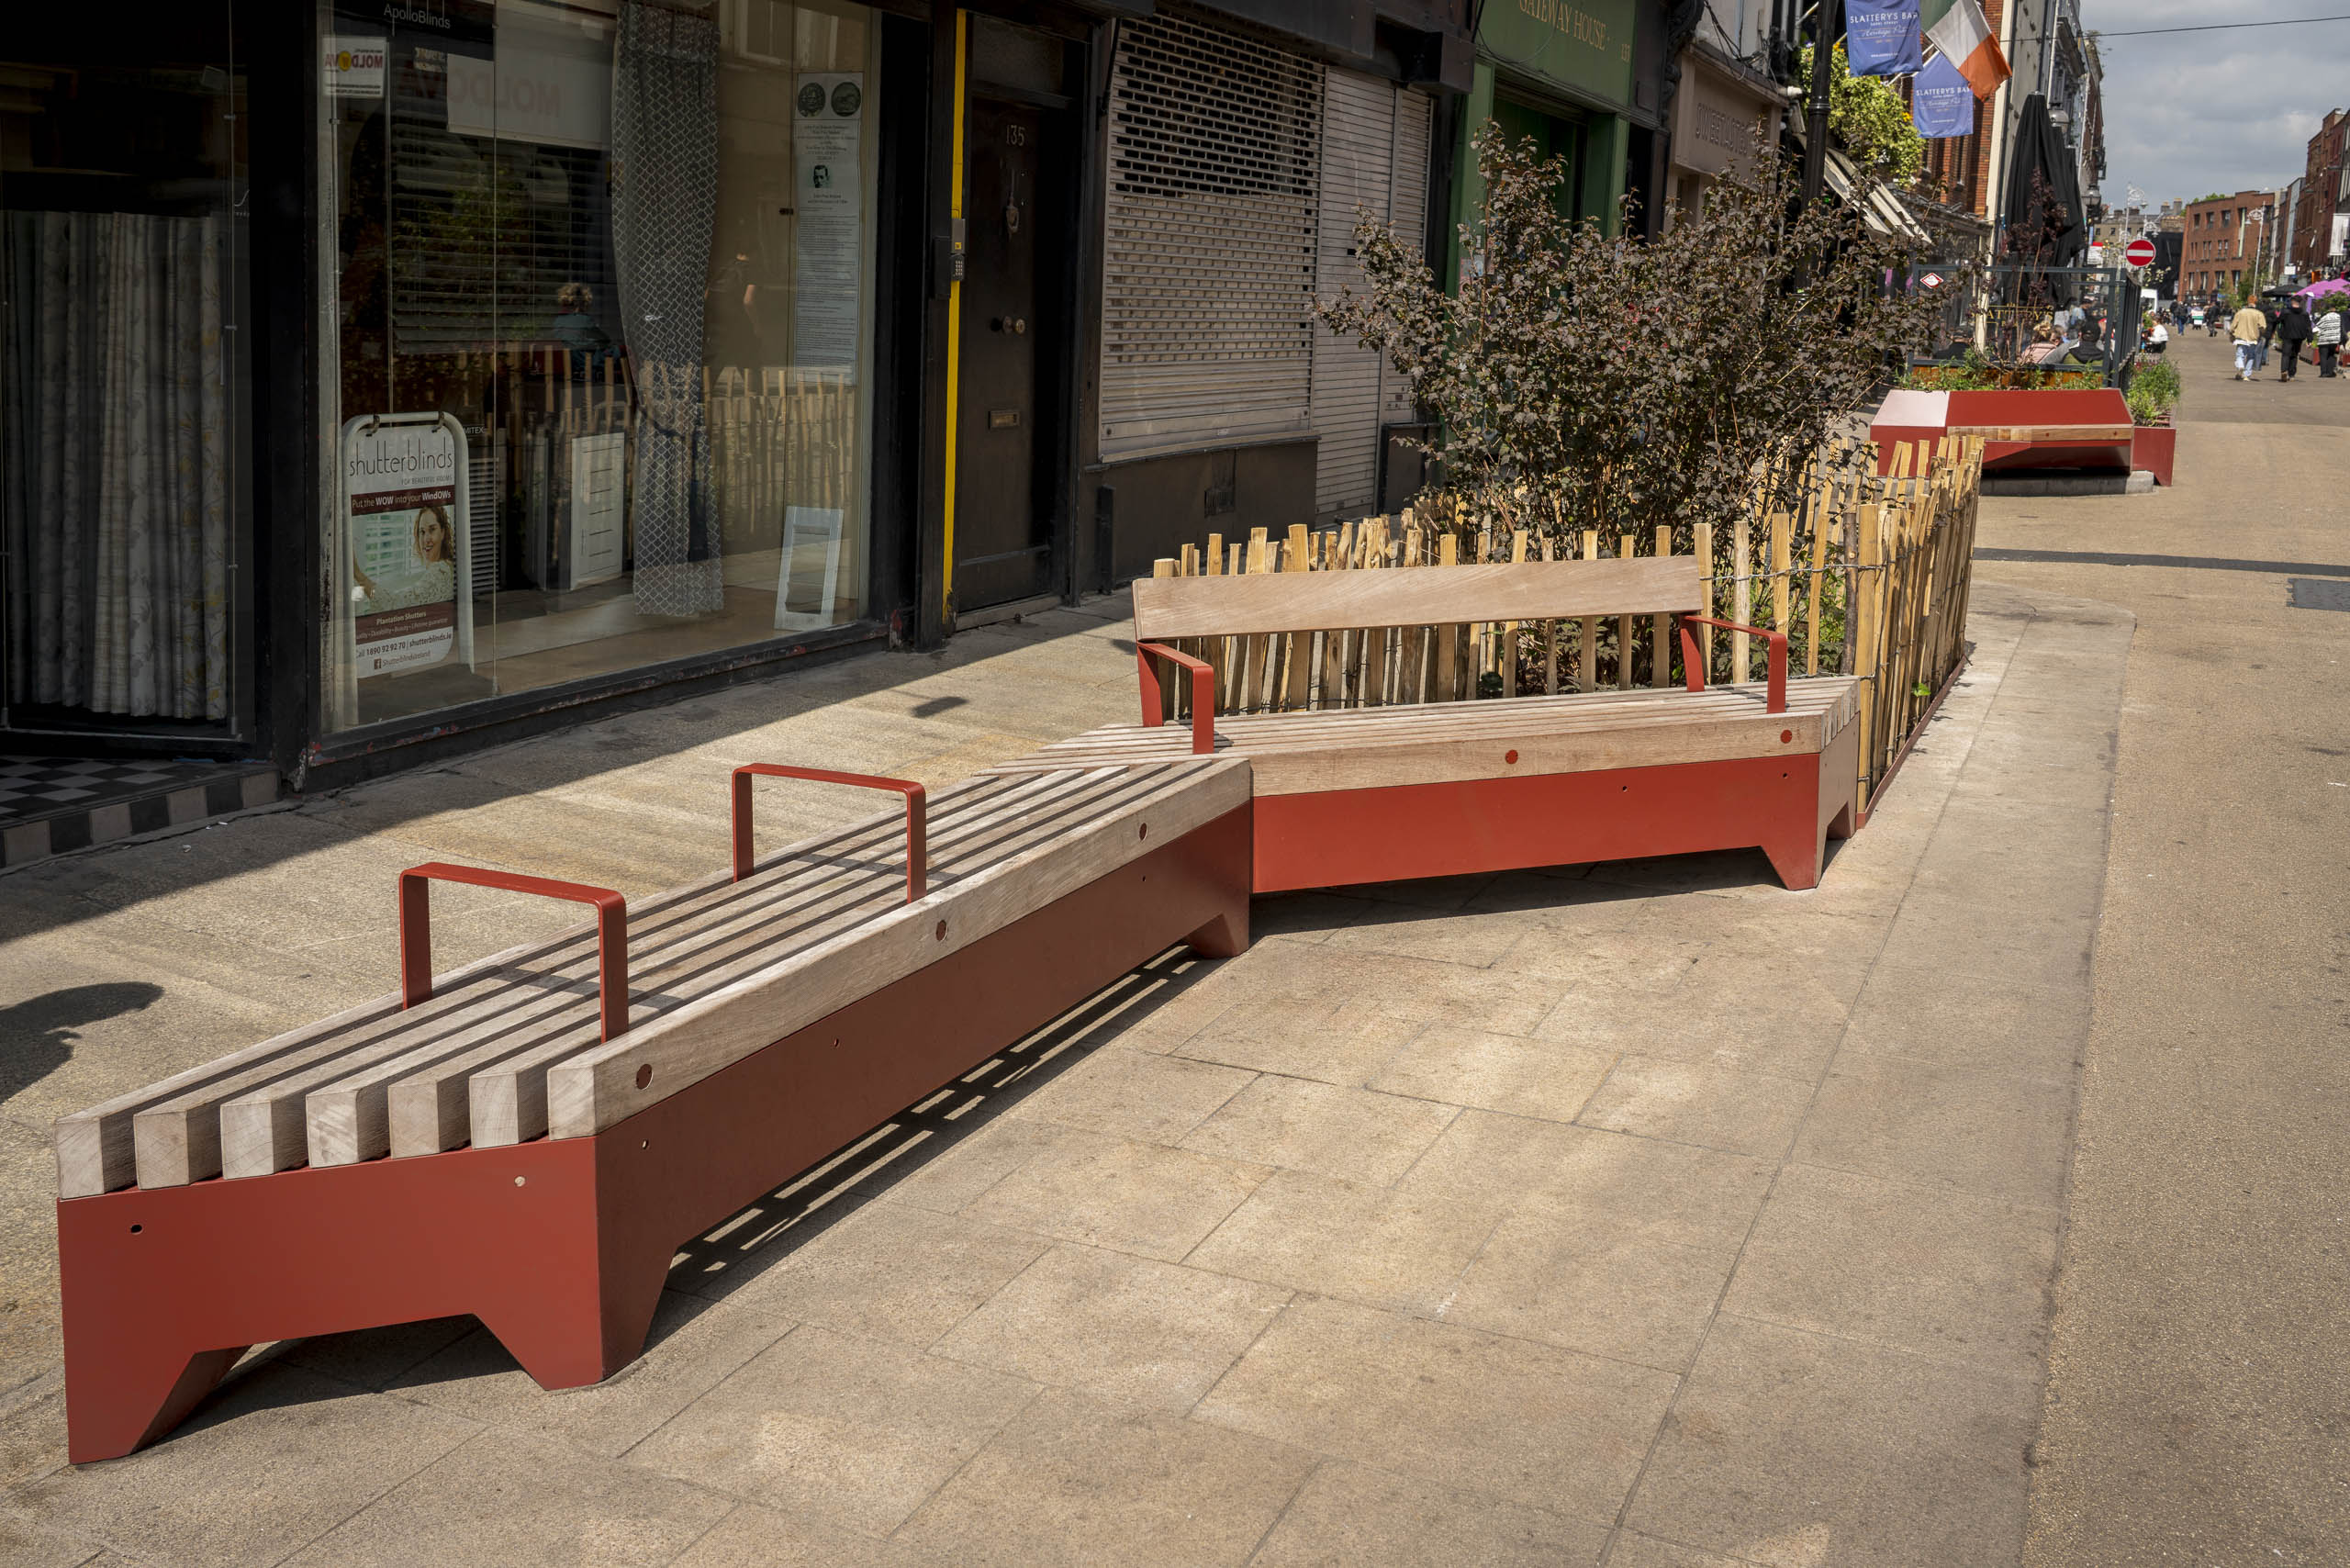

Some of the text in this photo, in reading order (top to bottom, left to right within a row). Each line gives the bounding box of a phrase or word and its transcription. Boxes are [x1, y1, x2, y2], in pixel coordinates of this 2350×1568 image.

[1572, 9, 1606, 51] HOUSE
[1005, 125, 1025, 147] 135
[349, 436, 453, 476] shutterblinds
[352, 498, 364, 510] Put
[375, 496, 394, 507] WOW
[375, 610, 427, 625] Plantation Shutters
[366, 645, 381, 655] 1890
[382, 644, 390, 653] 92
[390, 643, 397, 652] 92
[398, 641, 406, 650] 70
